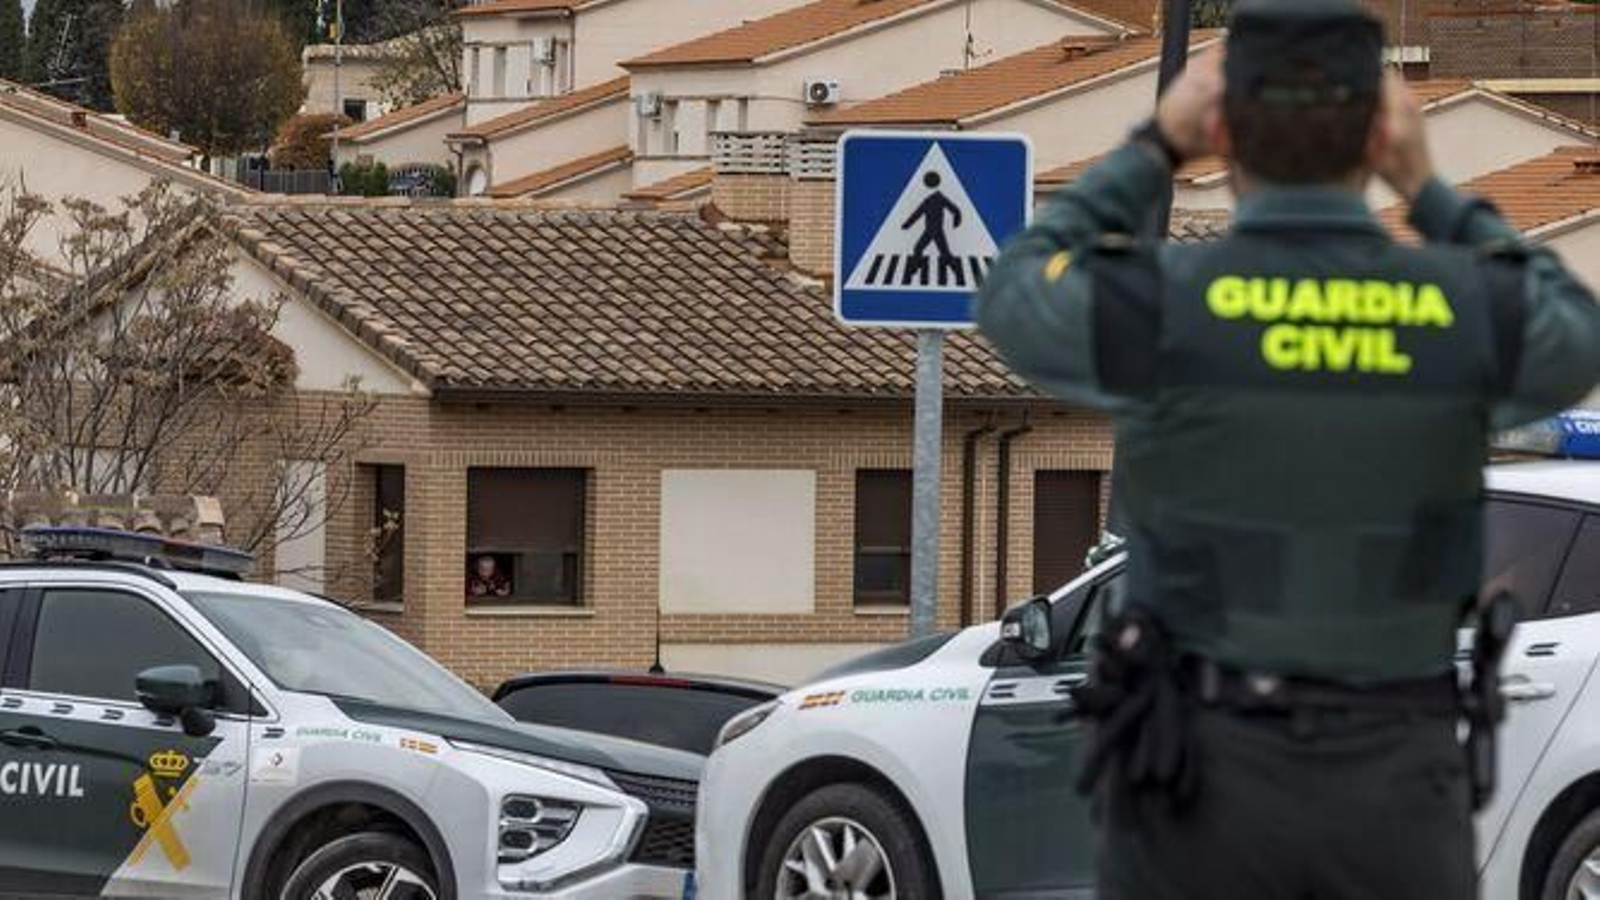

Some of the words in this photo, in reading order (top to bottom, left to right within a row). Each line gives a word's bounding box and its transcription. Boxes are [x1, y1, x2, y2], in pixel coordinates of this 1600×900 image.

[1207, 276, 1454, 326] GUARDIA
[1261, 325, 1412, 373] CIVIL
[851, 689, 923, 702] GUARDIA
[930, 688, 970, 700] CIVIL
[0, 761, 84, 797] CIVIL
